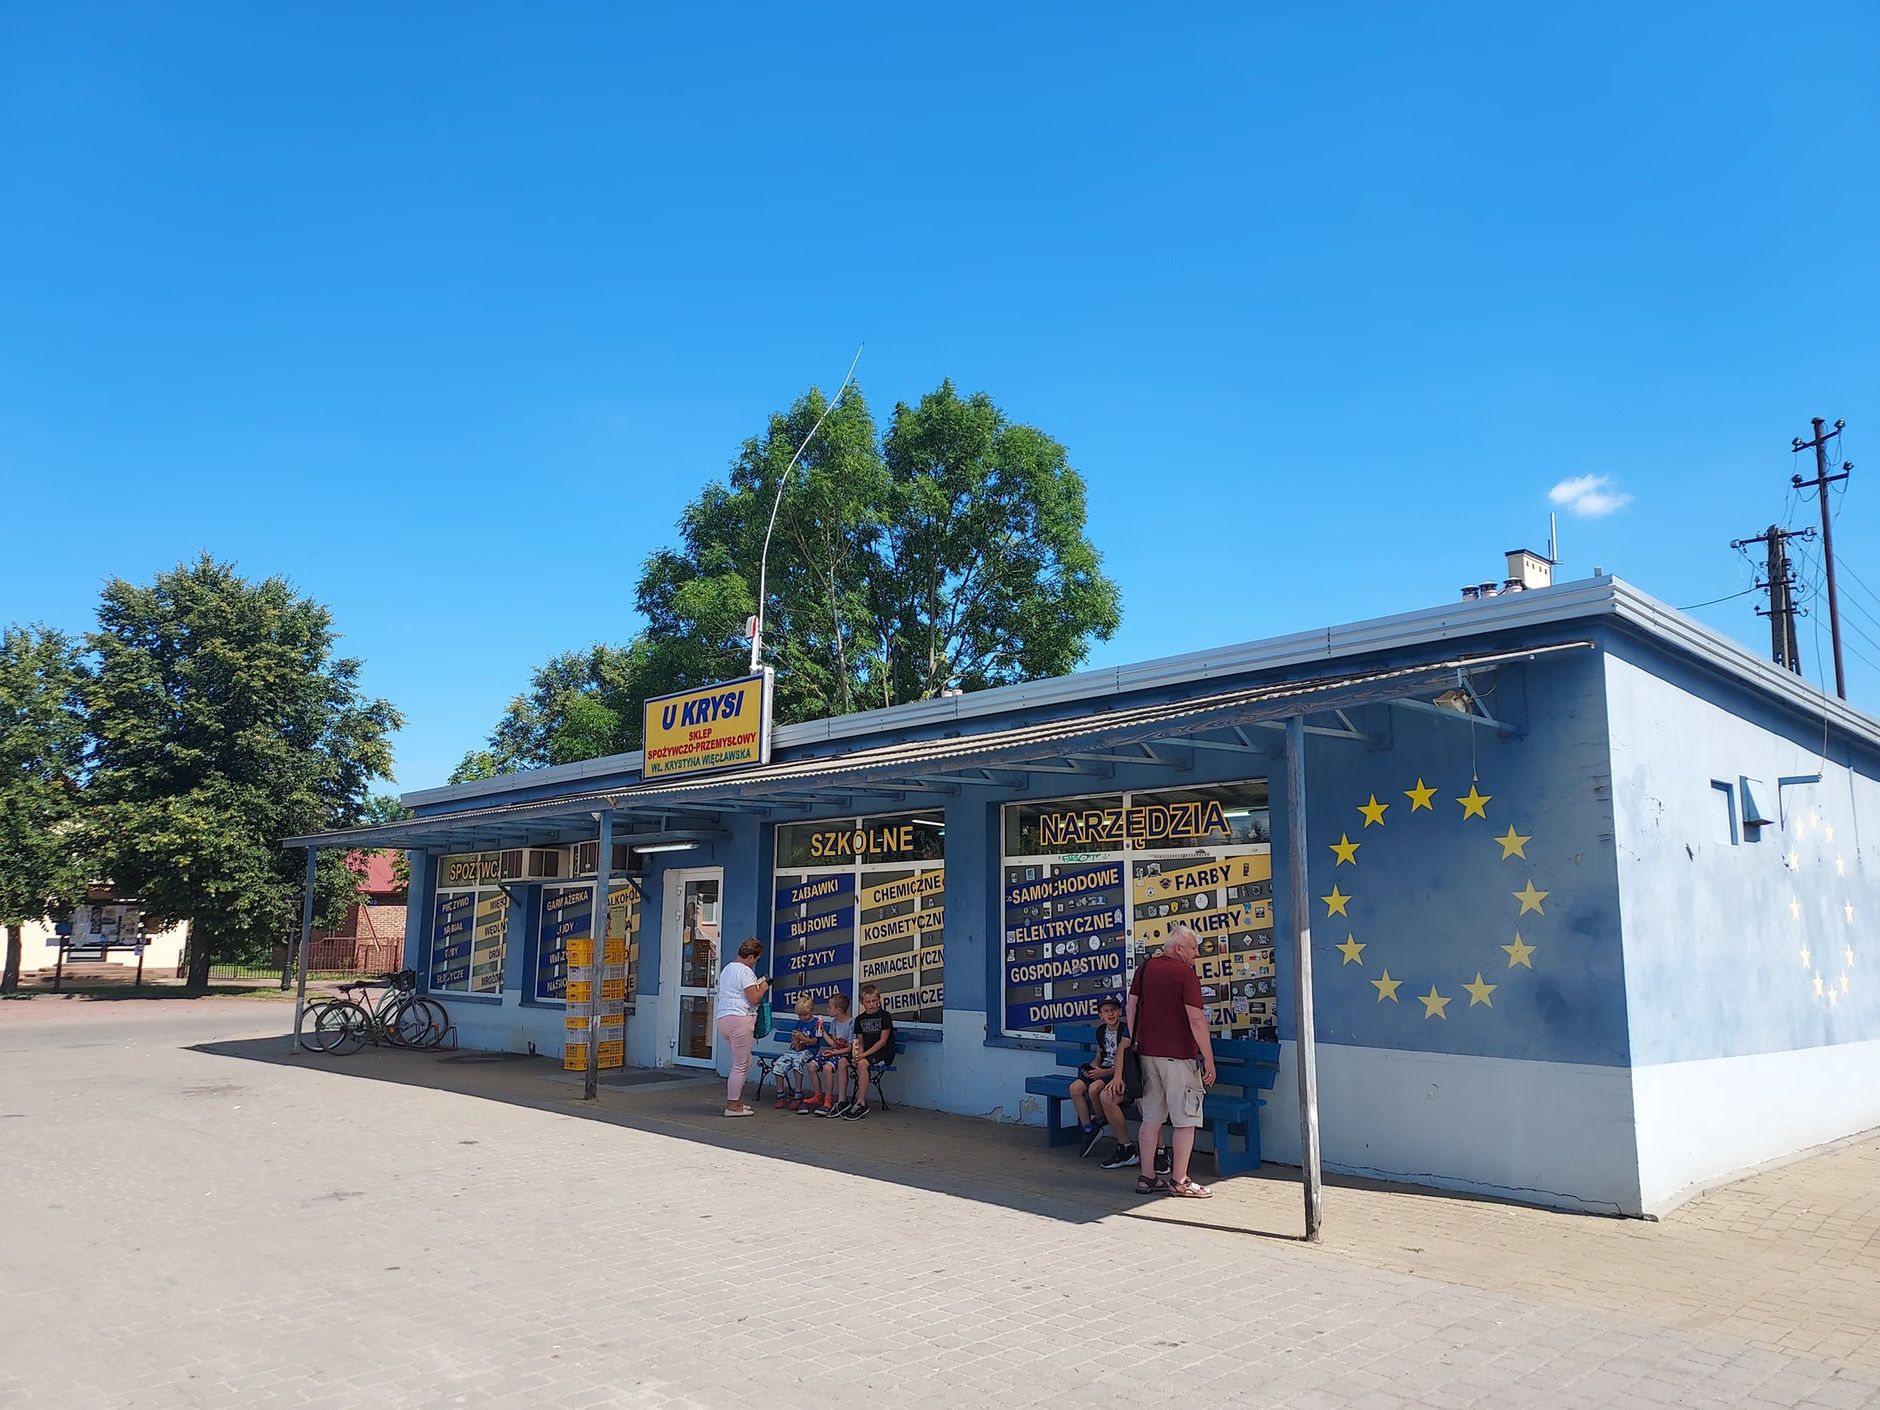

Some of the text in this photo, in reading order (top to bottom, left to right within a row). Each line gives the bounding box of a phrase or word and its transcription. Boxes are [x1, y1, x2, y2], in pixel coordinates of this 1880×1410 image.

[662, 690, 744, 730] U KRYSI
[647, 732, 757, 760] SPOŻYWCZO-PRZEMYSŁOWY
[688, 728, 712, 742] SKLEP
[651, 748, 752, 773] WŁ. KRYSTYNA WIĘCŁAWSKA
[1040, 800, 1232, 850] NARZĘDZIA
[810, 826, 914, 857] SZKOLNE
[791, 879, 839, 903] ZABAWKI
[873, 875, 941, 903] CHEMICZNE
[1012, 868, 1119, 904] SAMOCHODOWE
[1174, 864, 1232, 892] FARBY
[790, 913, 838, 937] BIUROWE
[864, 911, 944, 941] KOSMETYCZN
[1014, 912, 1115, 944] ELEKTRYCZNE
[790, 949, 836, 970] ZESZYTY
[863, 950, 944, 978] FARMACEUTYCZN
[1010, 952, 1120, 984] GOSPODARSTWO
[1029, 999, 1099, 1023] DOMOWE
